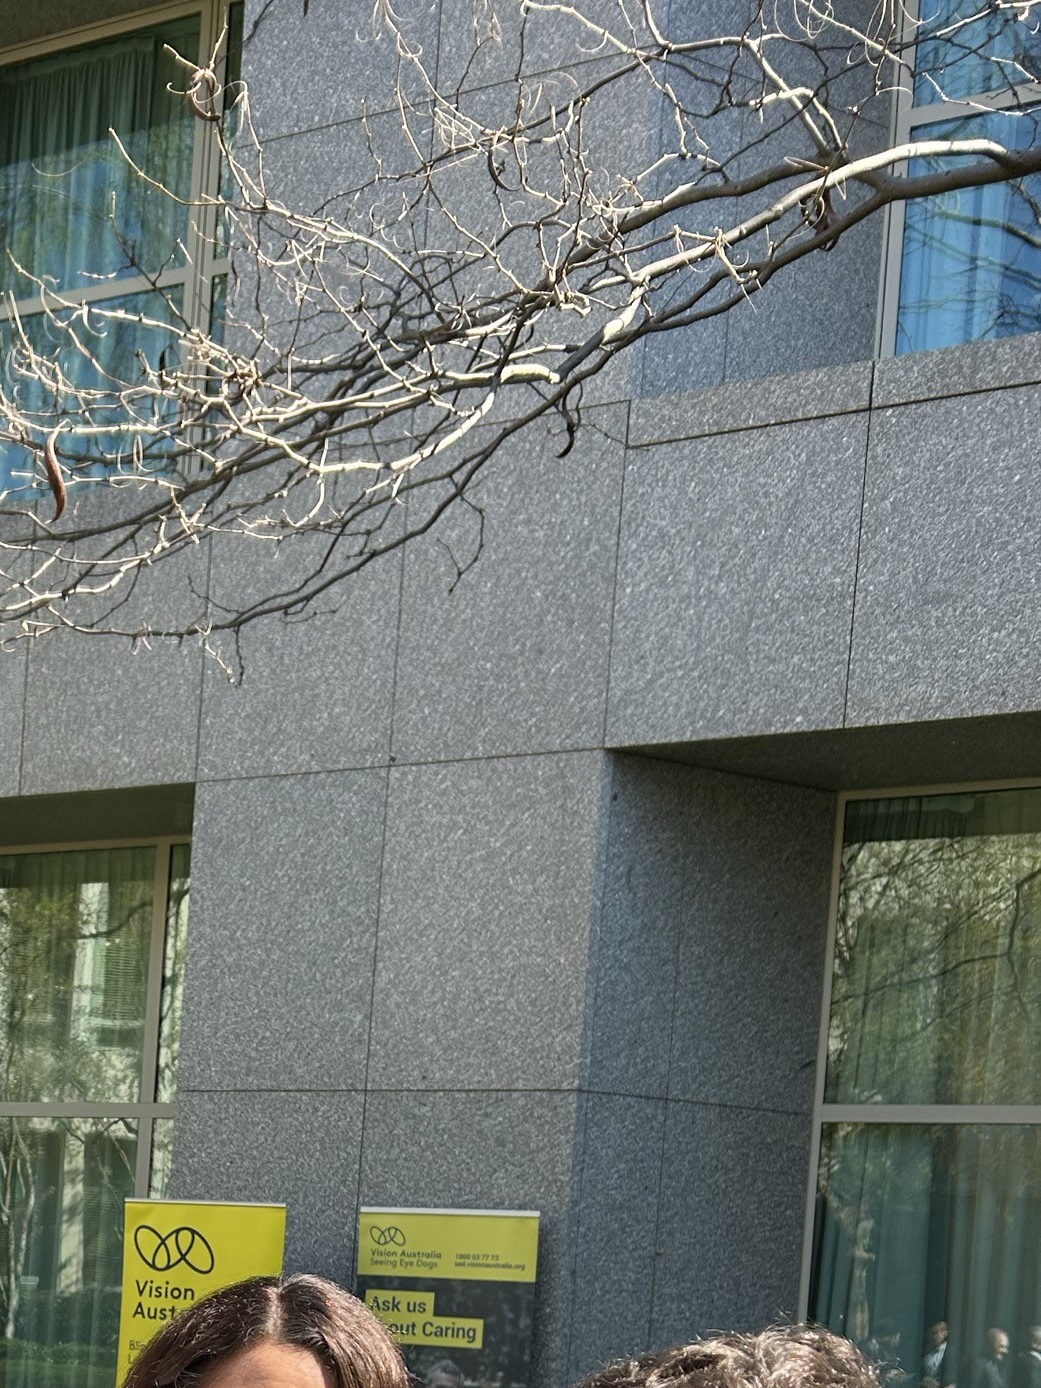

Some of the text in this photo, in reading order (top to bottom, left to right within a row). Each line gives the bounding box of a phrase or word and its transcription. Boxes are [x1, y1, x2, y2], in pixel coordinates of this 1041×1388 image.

[371, 1248, 442, 1259] Vision Australia
[370, 1258, 438, 1270] Seeing Eye Dogs
[135, 1279, 195, 1300] Vision
[370, 1296, 427, 1313] Ask us
[387, 1321, 477, 1343] out Caring
